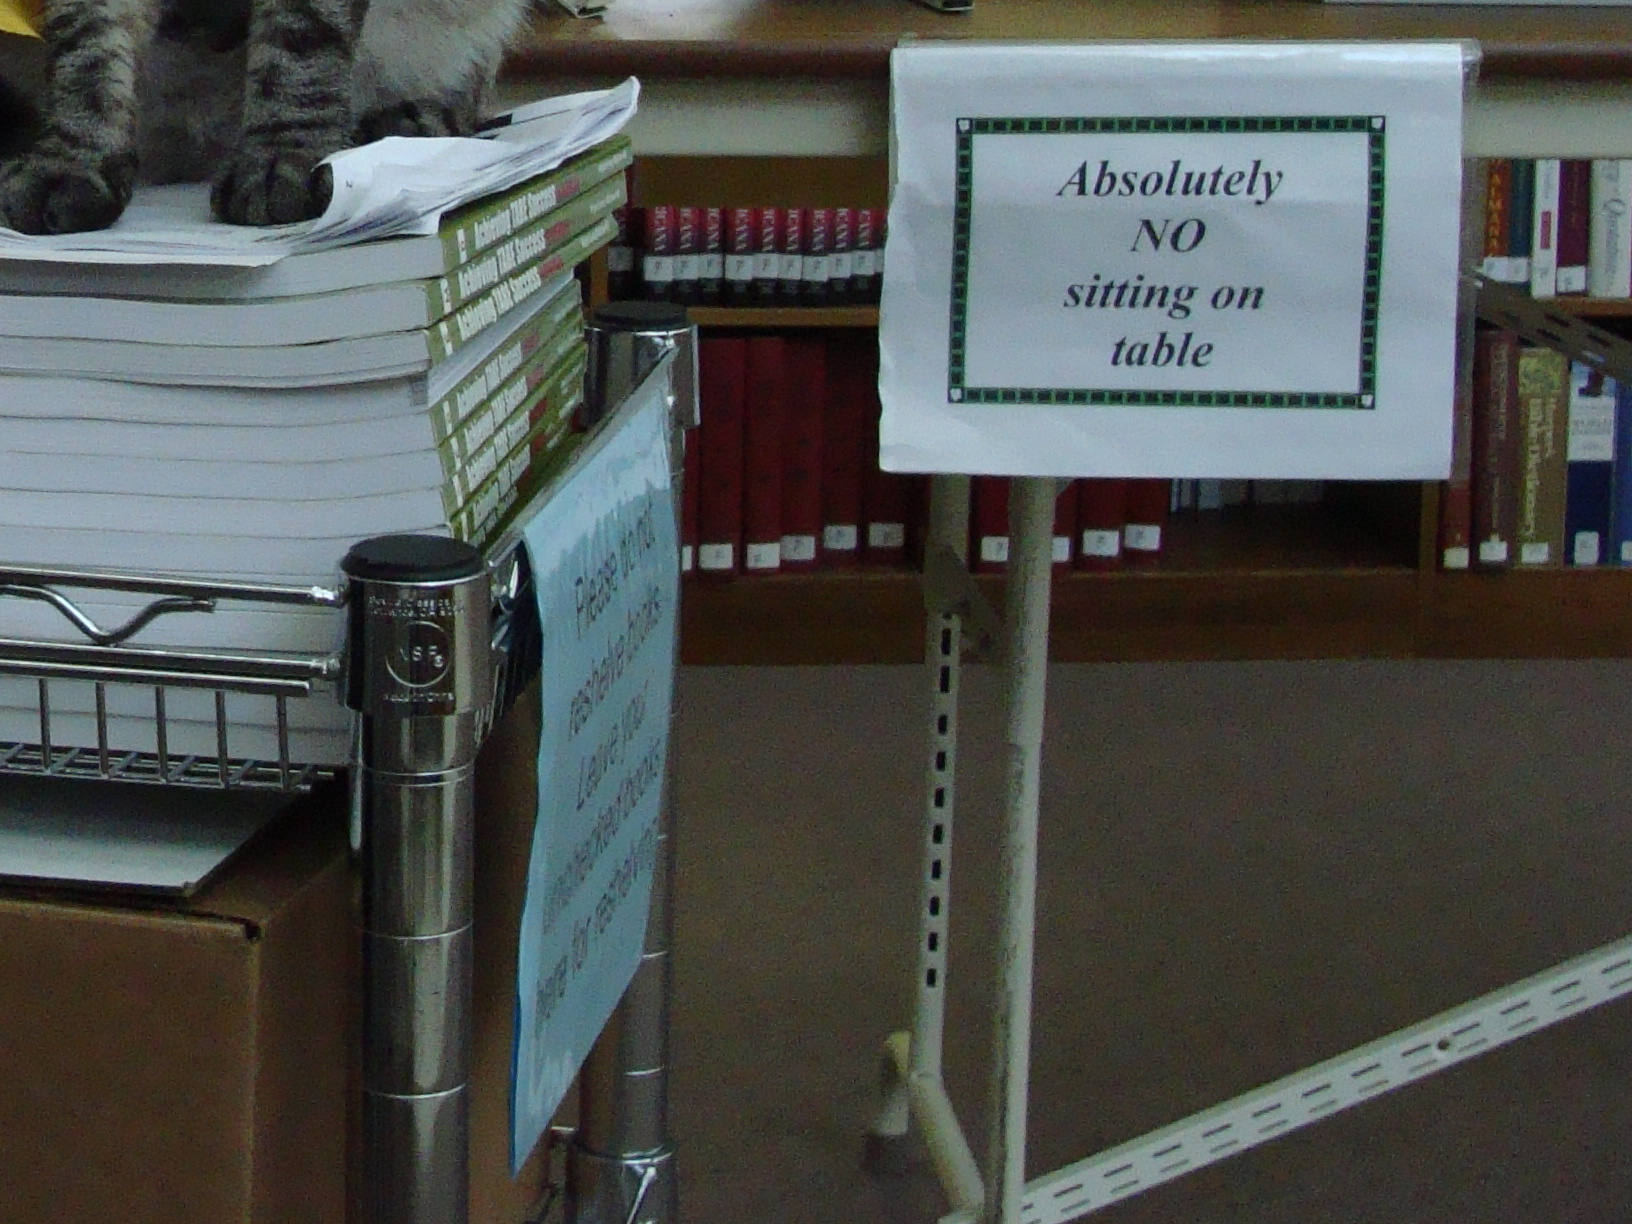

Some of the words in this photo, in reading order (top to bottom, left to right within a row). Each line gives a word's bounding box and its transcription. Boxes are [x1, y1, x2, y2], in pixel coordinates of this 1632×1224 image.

[1057, 159, 1283, 205] Absolutely
[1131, 218, 1206, 253] NO
[1064, 275, 1198, 319] sitting
[1211, 283, 1265, 310] on
[1110, 332, 1214, 368] table
[575, 550, 618, 640] Please
